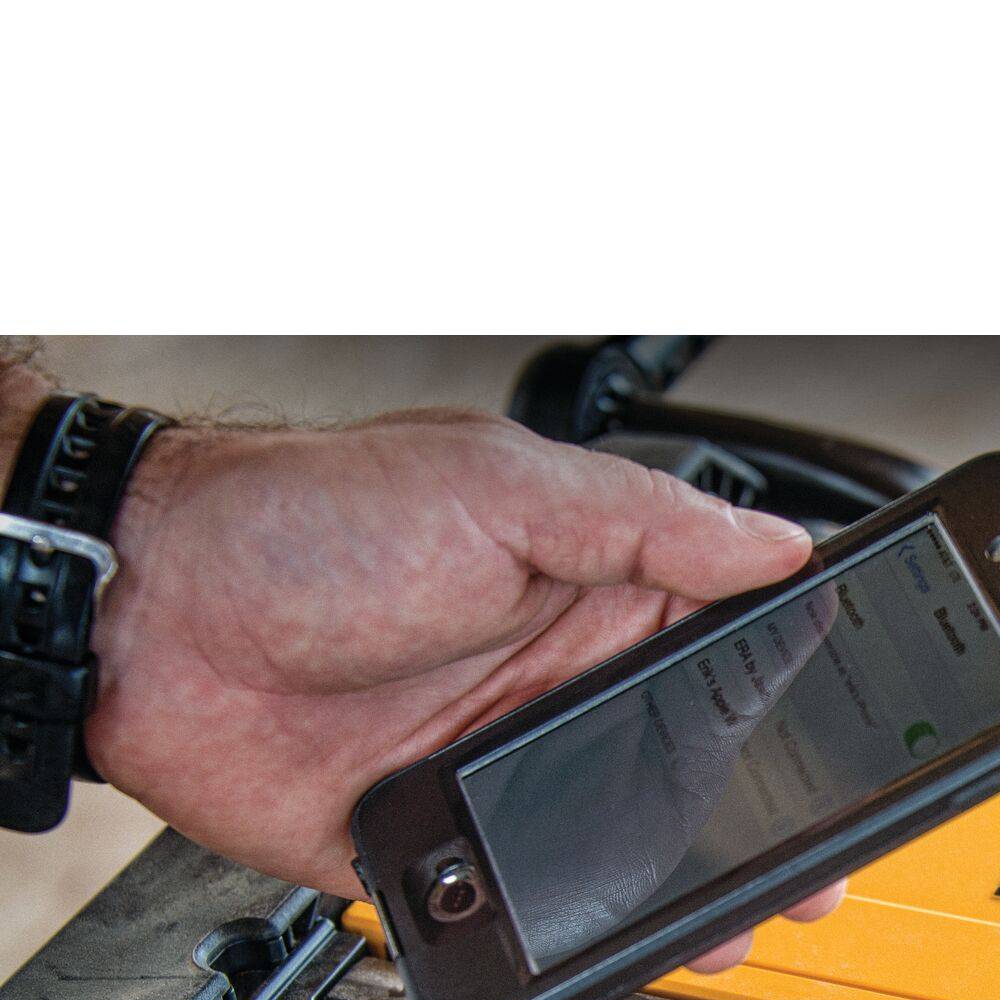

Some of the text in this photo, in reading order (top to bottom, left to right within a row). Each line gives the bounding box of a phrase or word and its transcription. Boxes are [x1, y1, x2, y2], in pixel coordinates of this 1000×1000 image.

[834, 583, 865, 629] Bluetooth
[734, 637, 753, 661] ERA
[934, 606, 966, 655] Bluetooth
